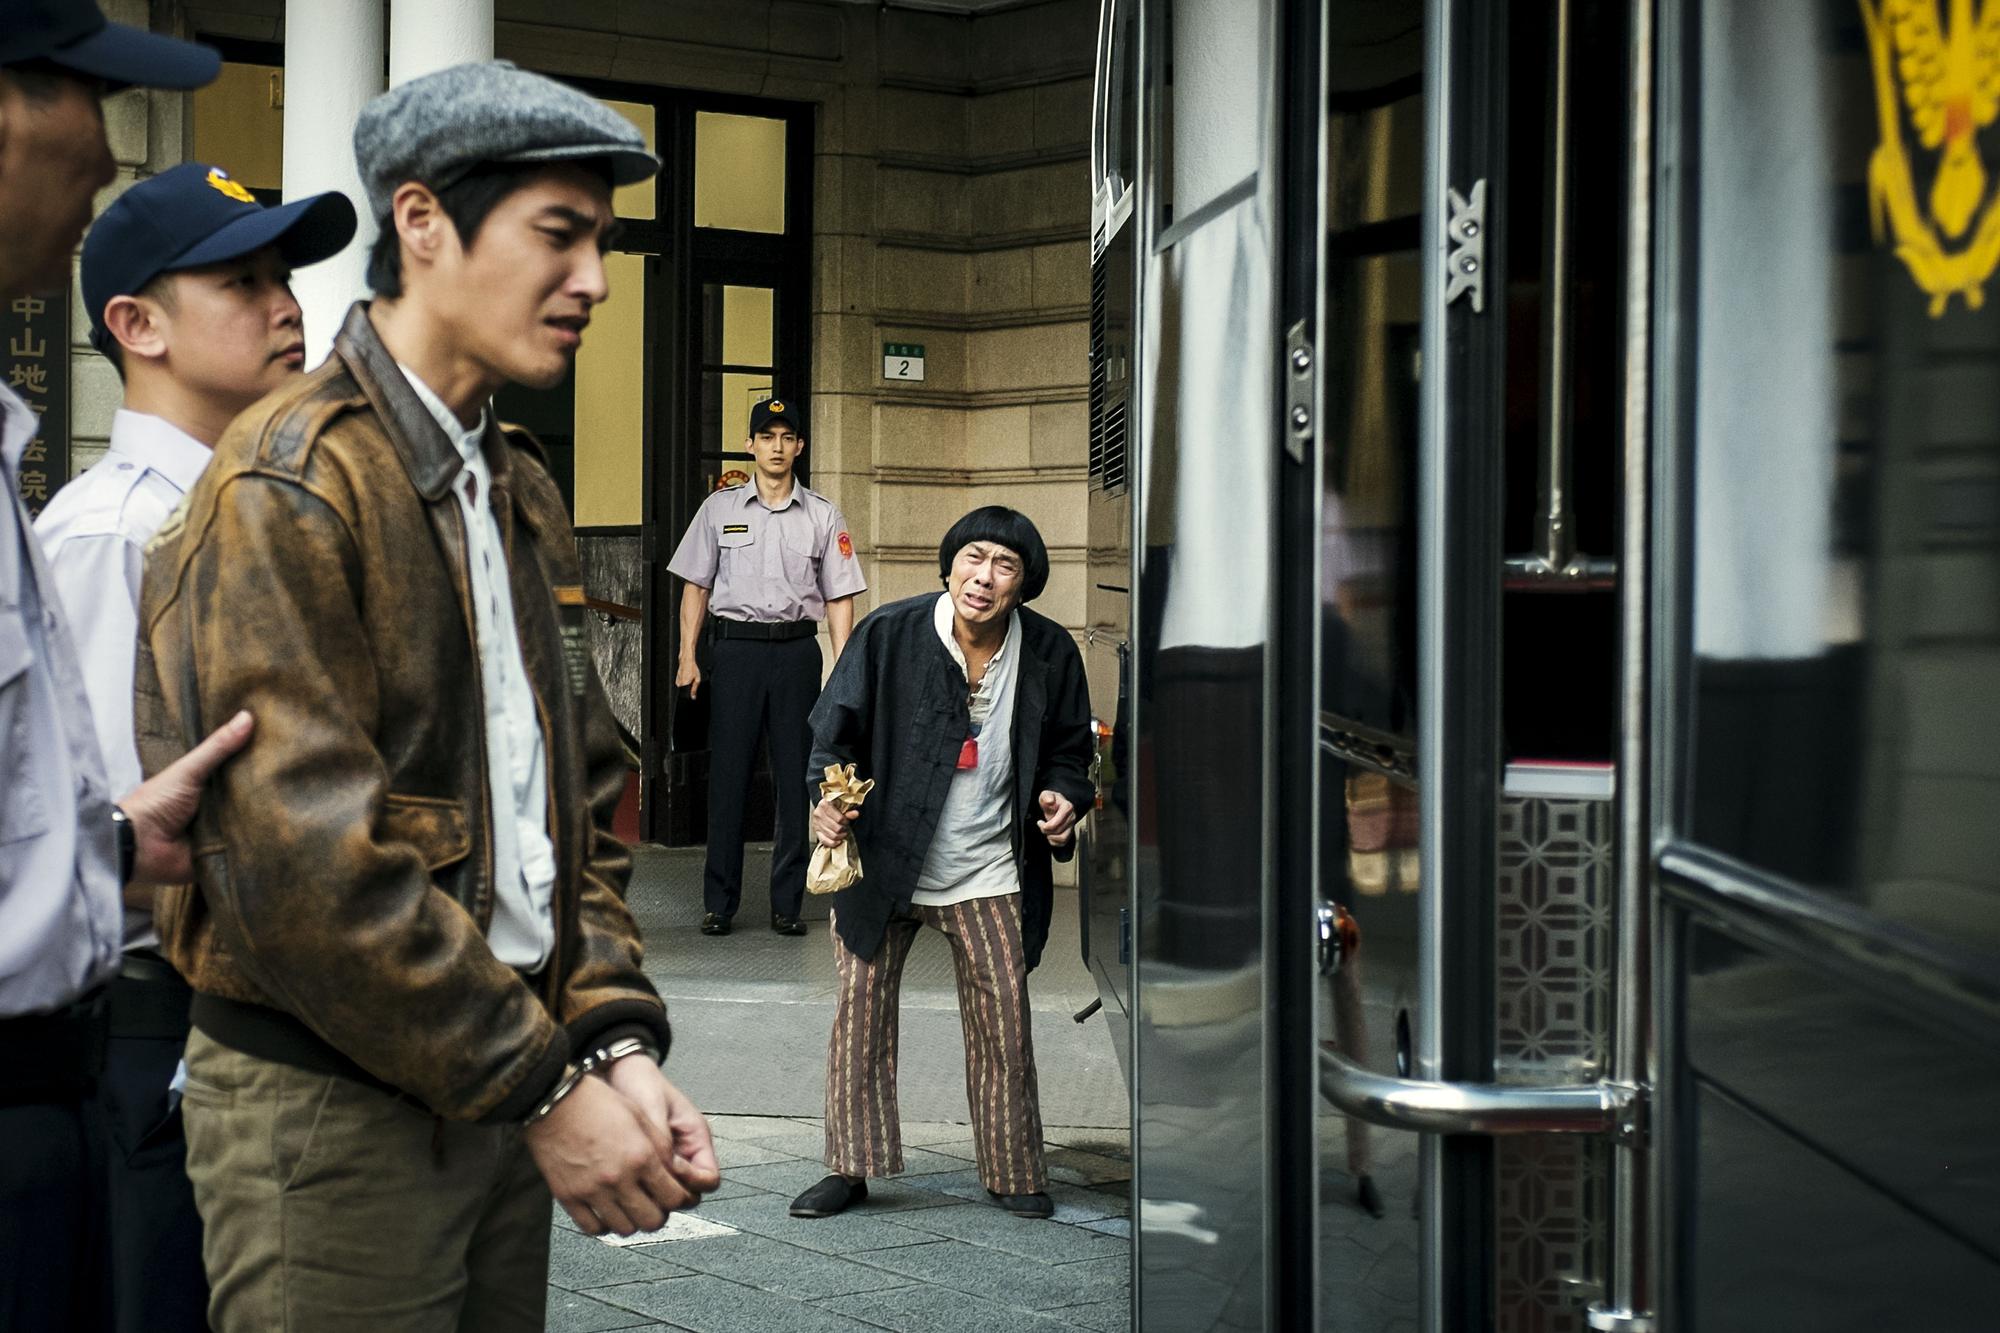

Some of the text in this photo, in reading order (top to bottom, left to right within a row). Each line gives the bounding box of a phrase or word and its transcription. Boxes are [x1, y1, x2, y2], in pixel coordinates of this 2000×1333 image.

[9, 294, 48, 518] 中山地法院
[899, 360, 910, 376] 2
